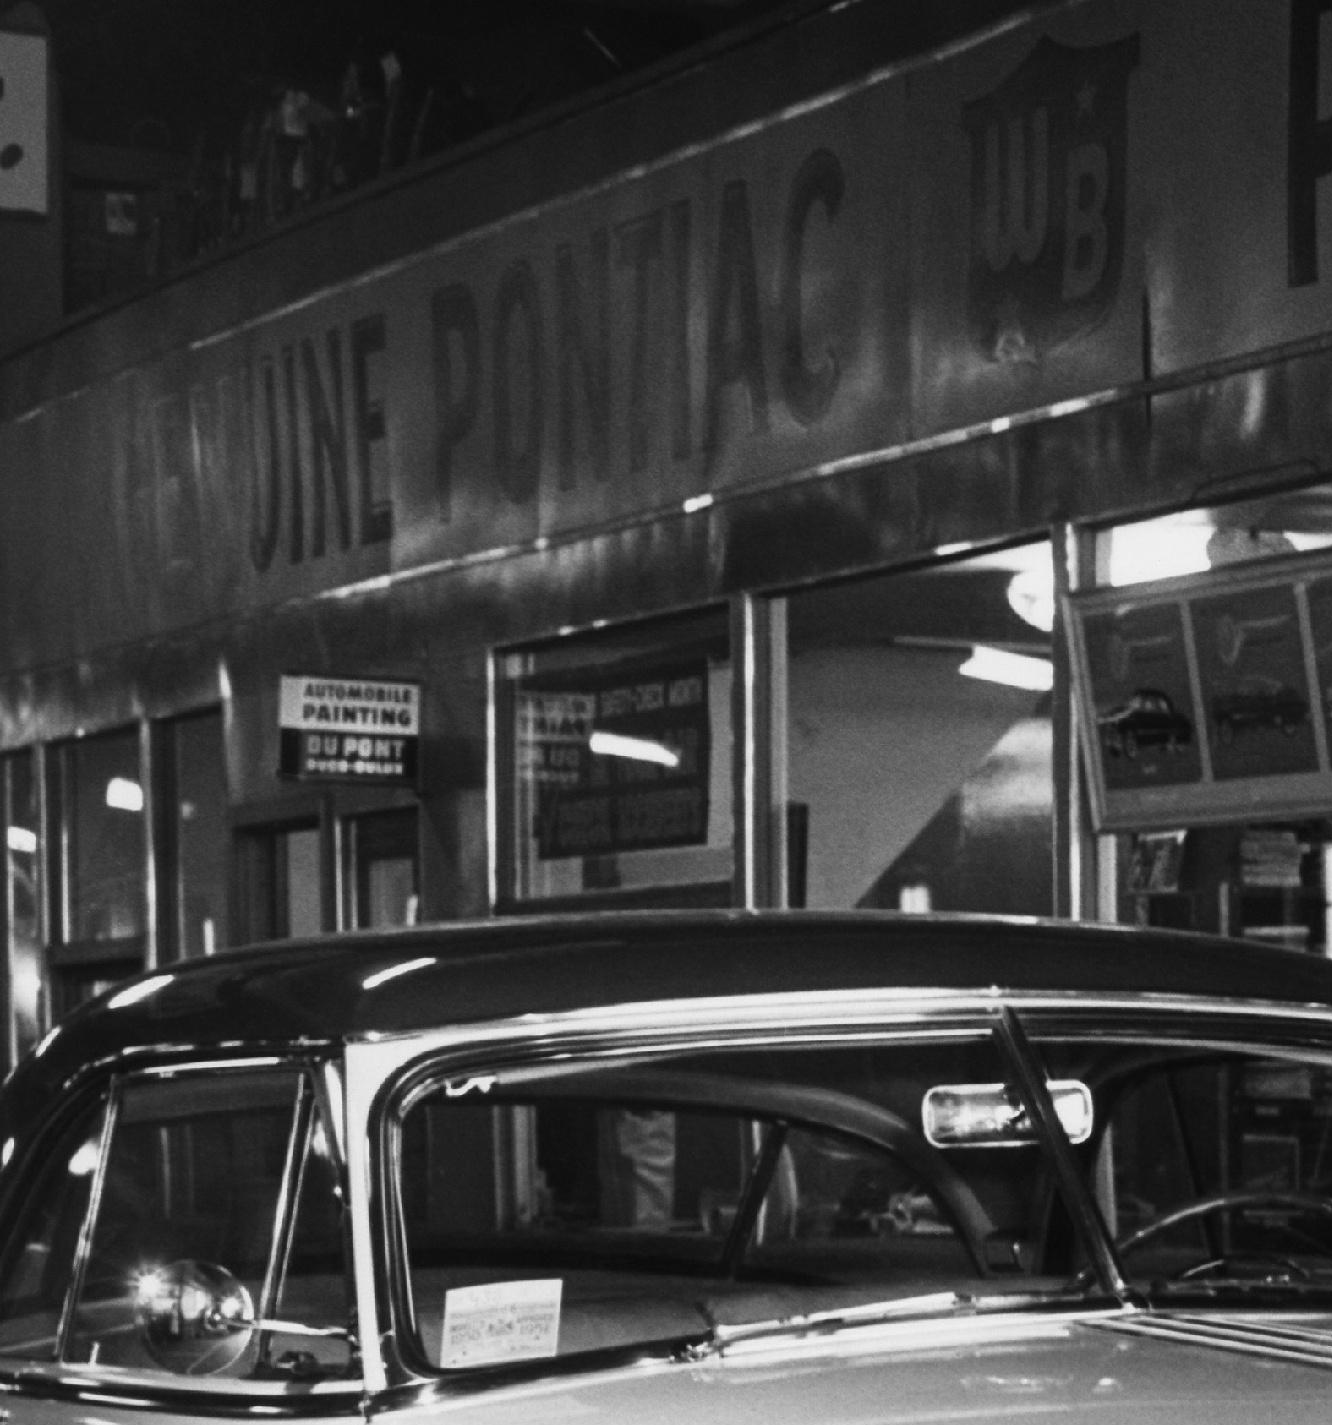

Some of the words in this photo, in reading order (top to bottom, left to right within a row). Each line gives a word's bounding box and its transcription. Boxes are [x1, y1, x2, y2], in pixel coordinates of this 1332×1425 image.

[430, 148, 846, 525] PONTIAC
[303, 683, 412, 703] AUTOMOBILE
[302, 704, 412, 726] PAINTING
[342, 736, 405, 759] PONT
